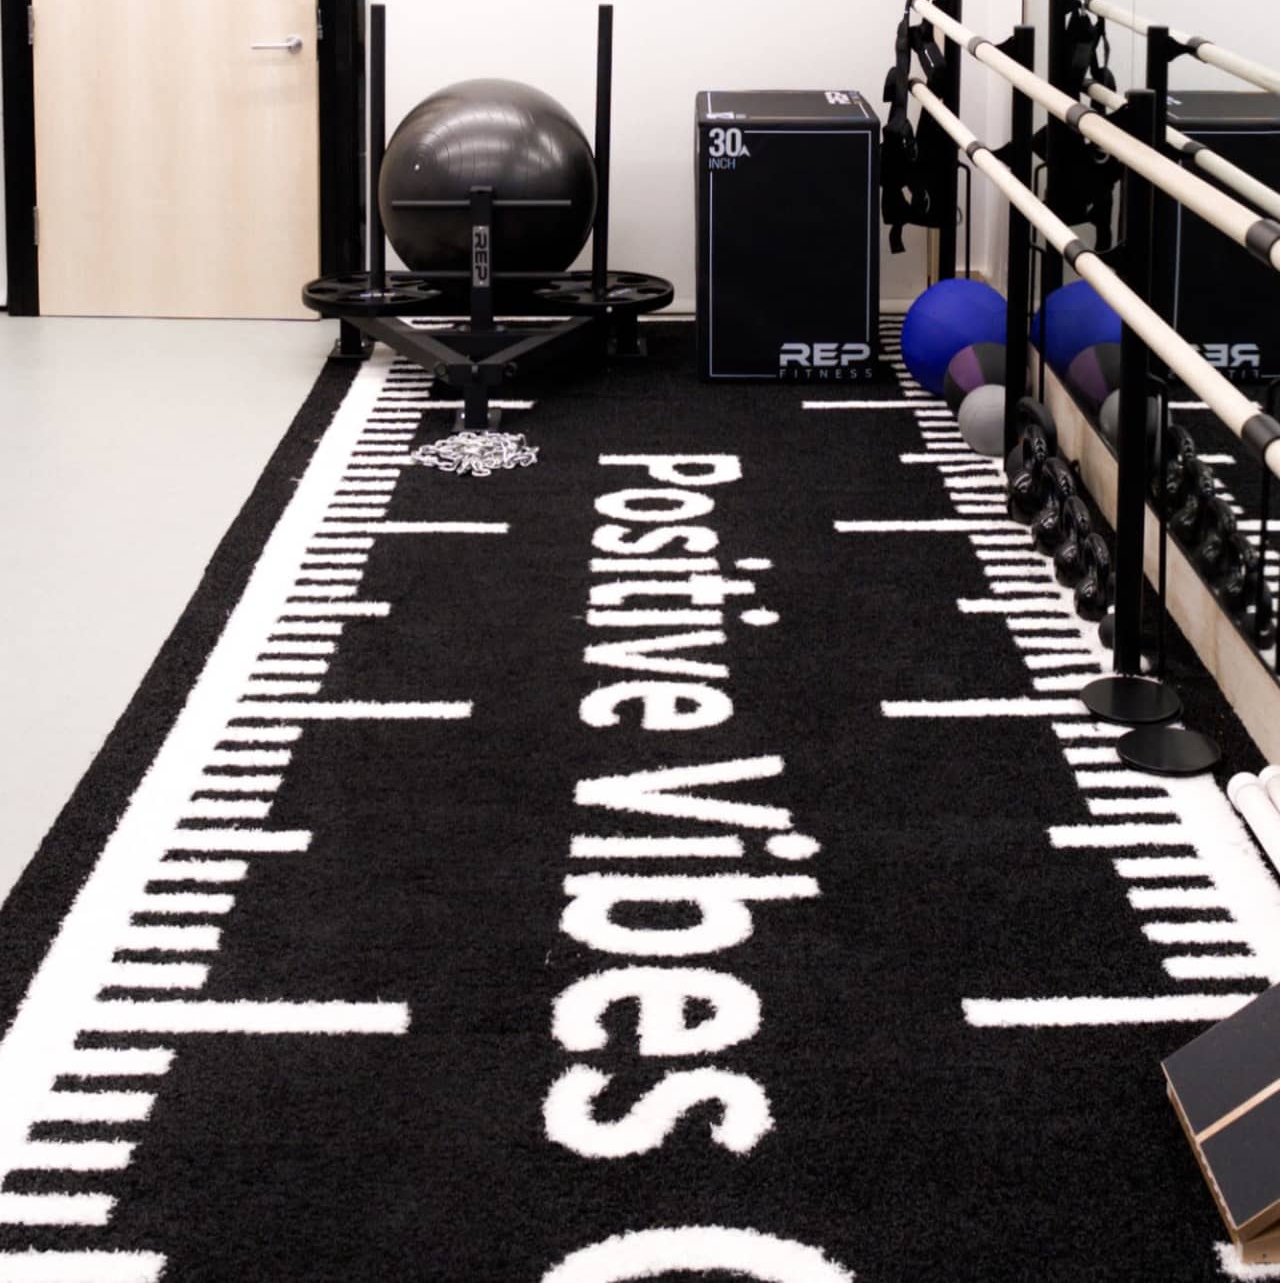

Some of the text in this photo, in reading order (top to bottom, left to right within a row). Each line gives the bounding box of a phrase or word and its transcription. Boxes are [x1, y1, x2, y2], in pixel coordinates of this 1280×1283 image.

[708, 158, 737, 170] INCH
[474, 232, 488, 281] REP
[779, 342, 871, 367] REP
[779, 368, 873, 379] FITNESS
[580, 454, 779, 730] Positive
